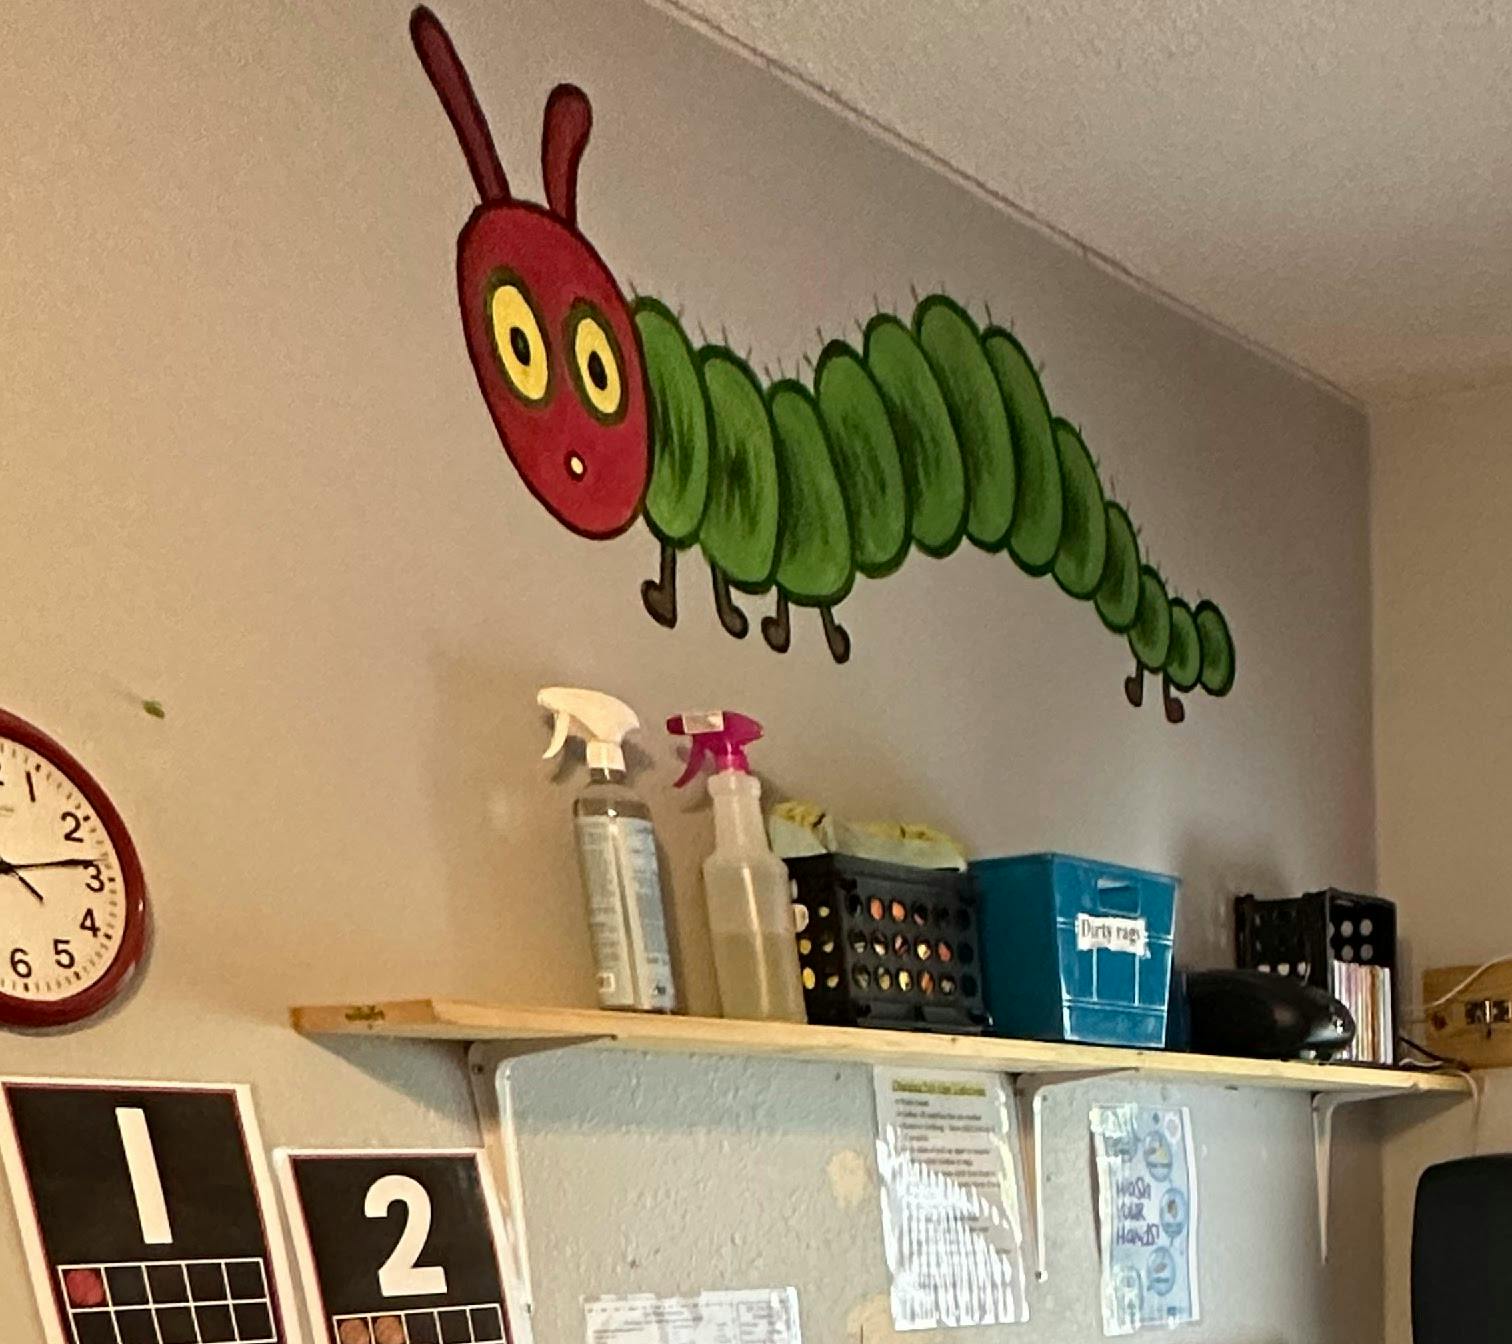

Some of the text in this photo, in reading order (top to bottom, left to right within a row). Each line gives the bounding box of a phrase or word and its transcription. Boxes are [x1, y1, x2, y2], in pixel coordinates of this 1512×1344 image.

[26, 771, 35, 802] 1
[61, 812, 84, 843] 2
[83, 861, 104, 892] 3
[81, 908, 100, 937] 4
[1082, 919, 1111, 942] Dirty
[11, 948, 31, 978] 6
[53, 939, 75, 969] 5
[116, 1107, 172, 1244] 1
[364, 1175, 448, 1297] 2
